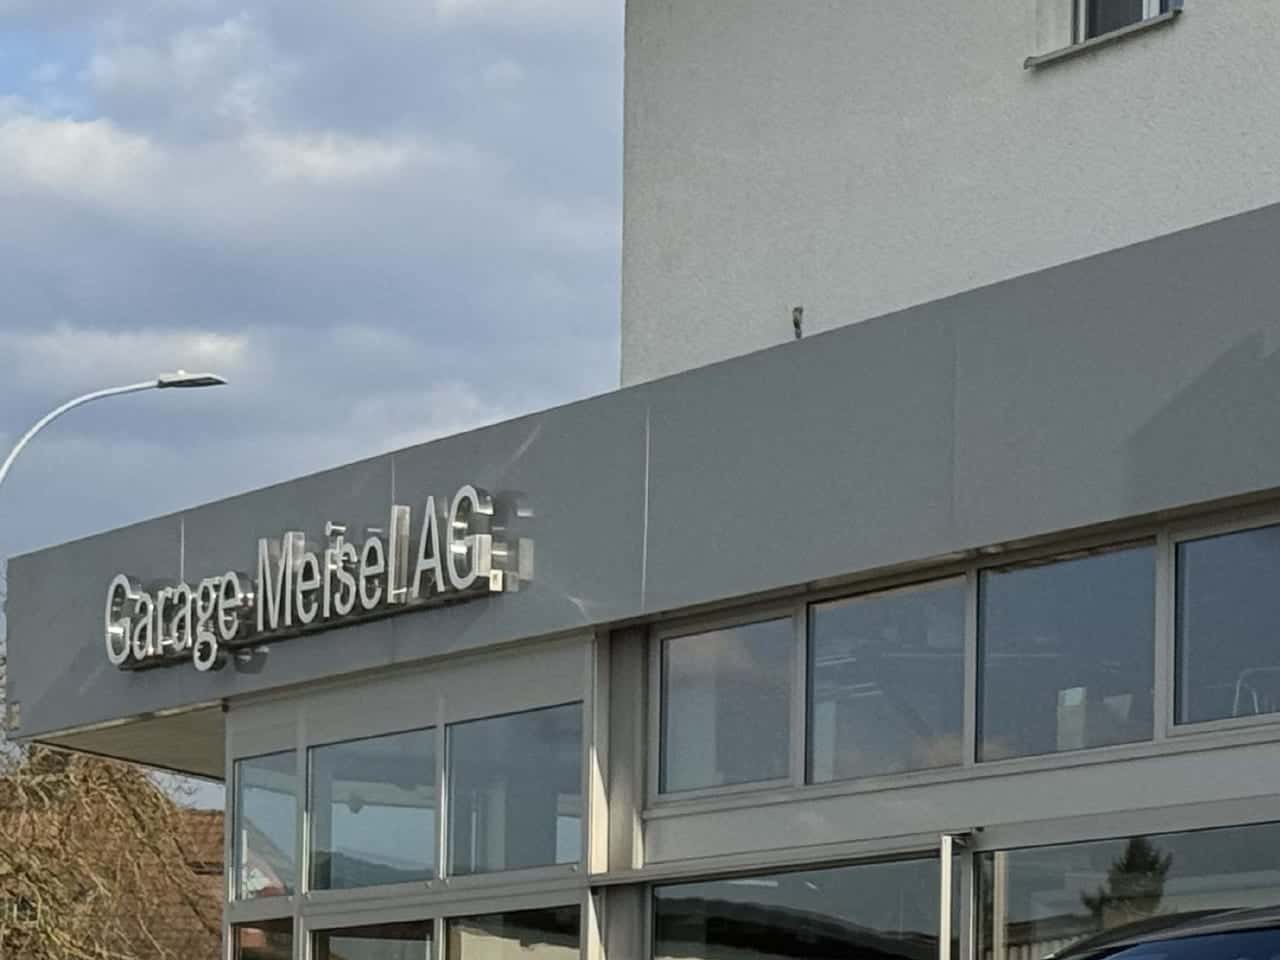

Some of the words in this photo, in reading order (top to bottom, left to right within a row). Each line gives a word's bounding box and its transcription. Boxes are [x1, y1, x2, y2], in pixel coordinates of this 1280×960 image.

[104, 572, 243, 672] Garage
[256, 504, 410, 633] Meisel
[412, 484, 493, 598] AG
